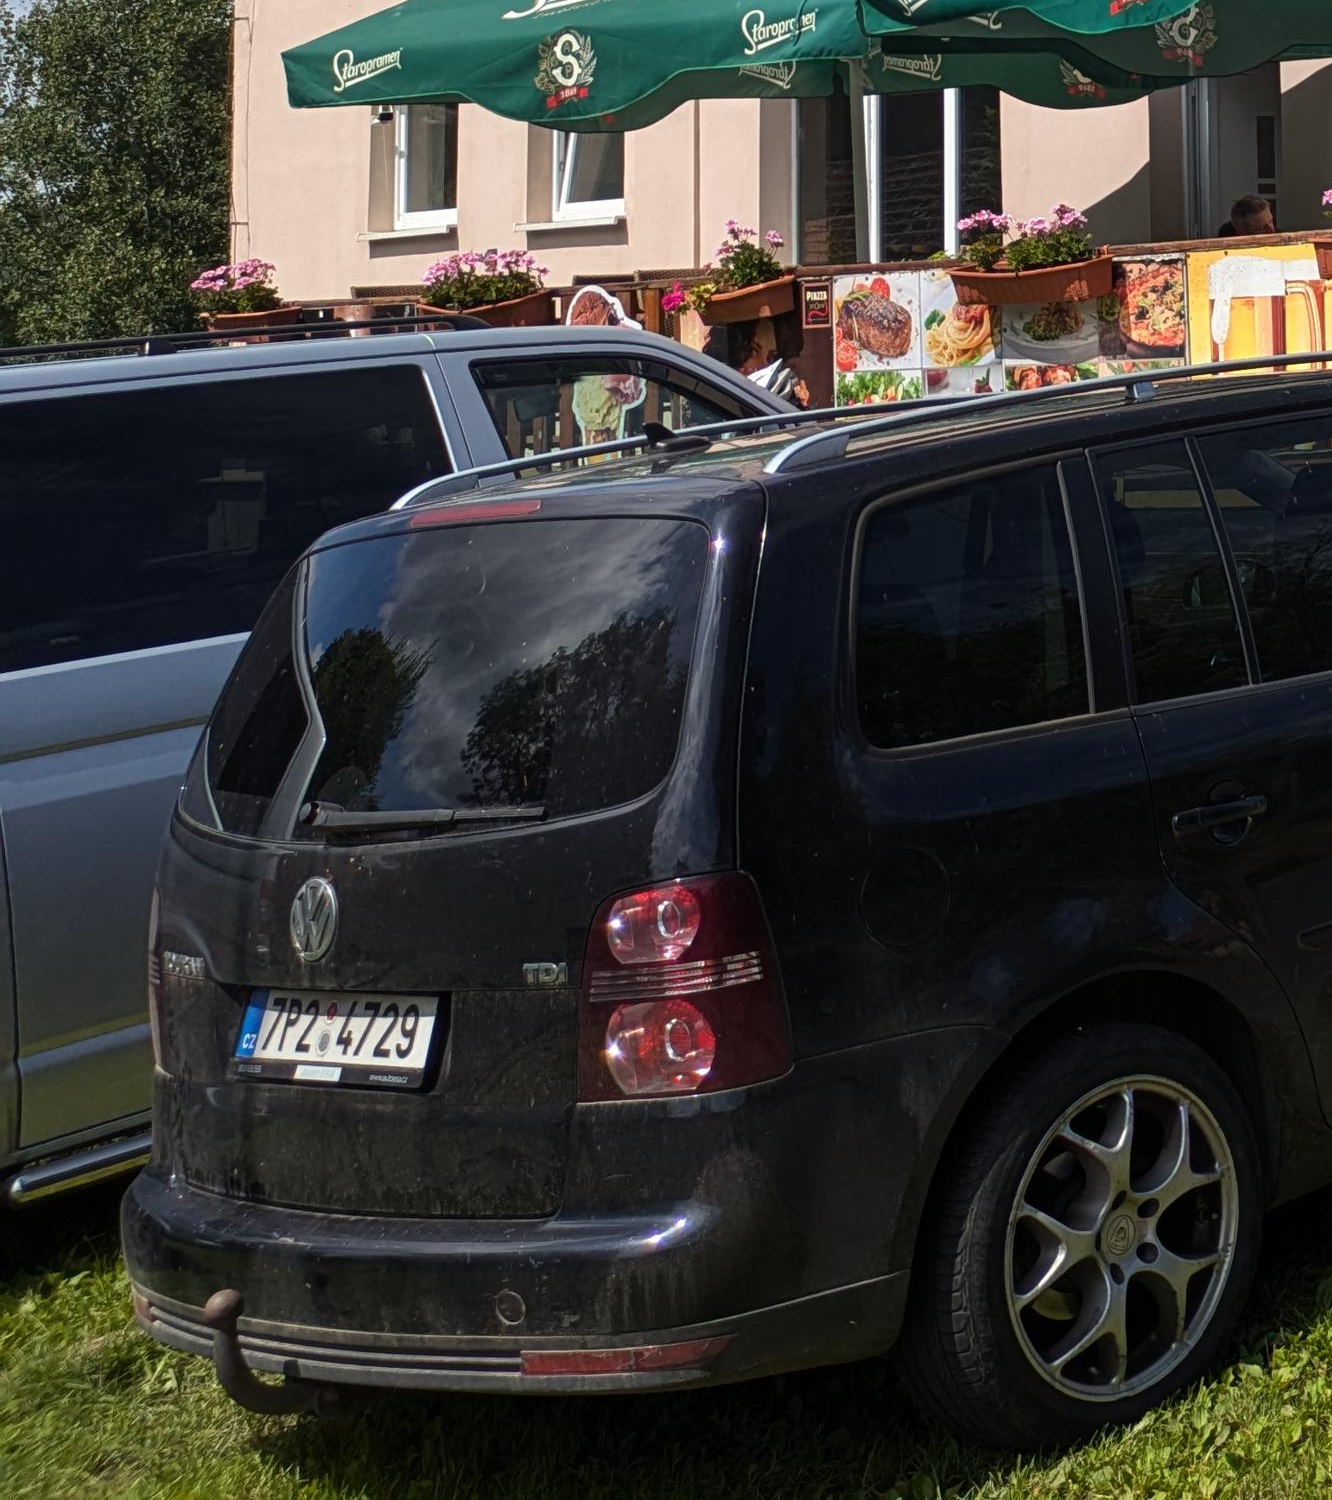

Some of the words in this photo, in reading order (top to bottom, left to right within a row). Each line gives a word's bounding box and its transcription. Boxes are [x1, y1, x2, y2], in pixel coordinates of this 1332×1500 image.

[334, 49, 402, 92] Staropramen
[522, 962, 568, 986] TDI
[242, 1033, 256, 1049] CZ
[261, 997, 321, 1053] 7P2
[335, 1000, 421, 1060] 4729
